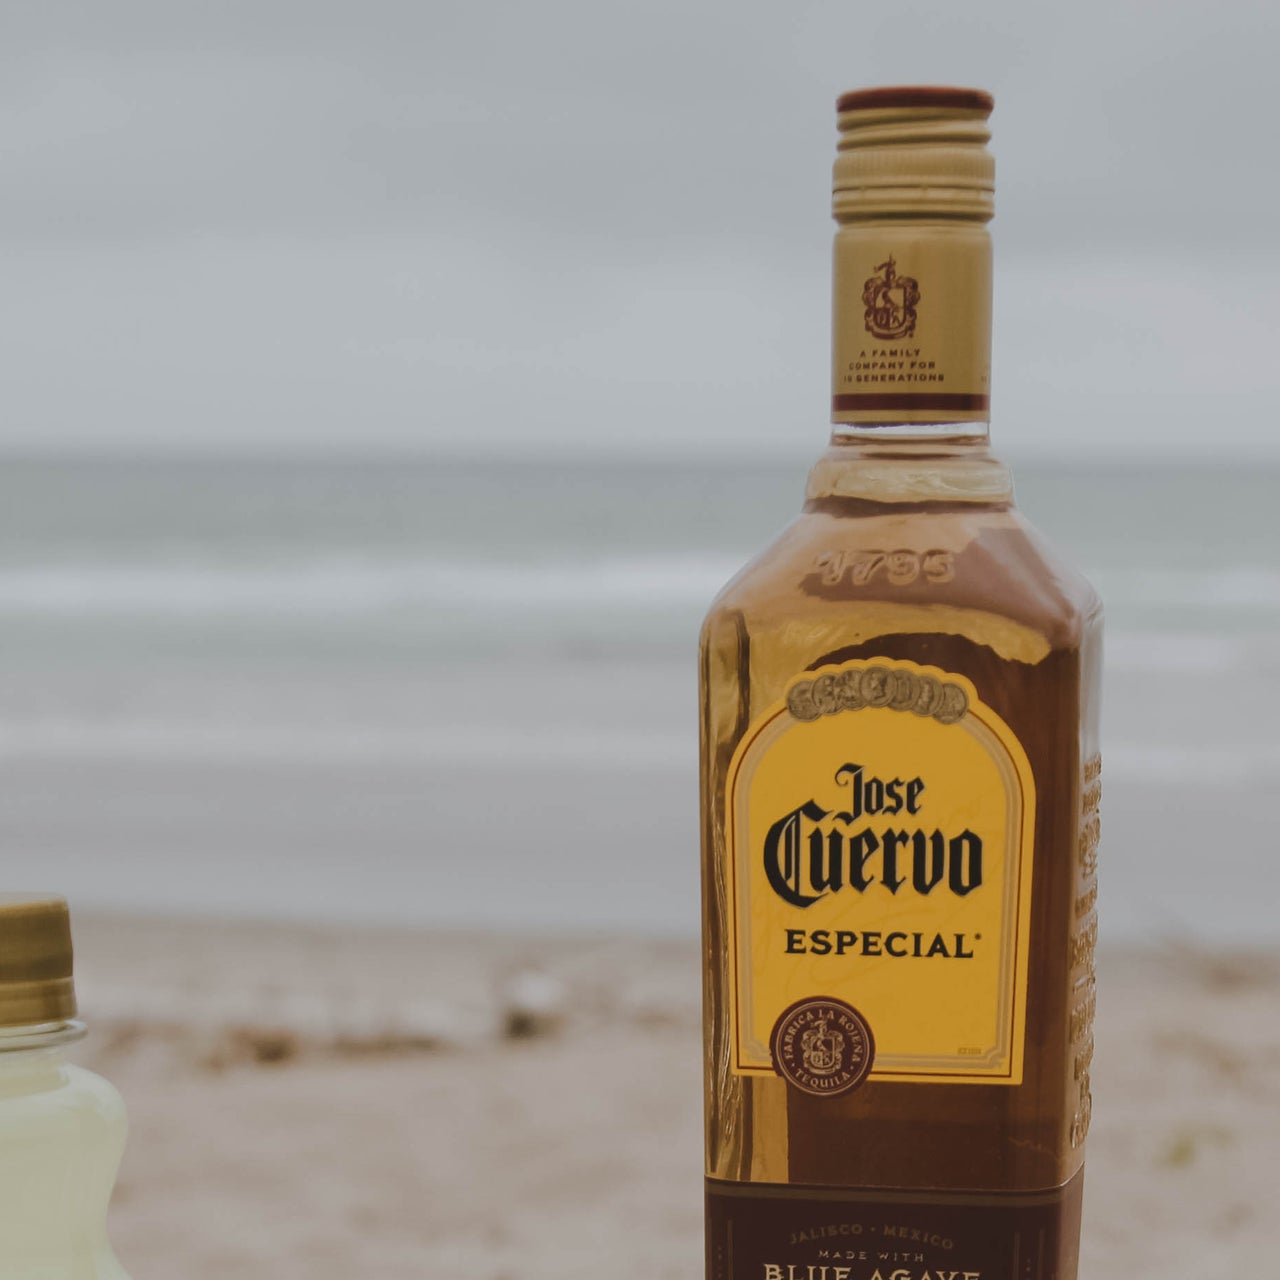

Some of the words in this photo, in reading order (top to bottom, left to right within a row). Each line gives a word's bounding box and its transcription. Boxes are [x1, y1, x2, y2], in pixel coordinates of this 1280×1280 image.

[848, 361, 904, 370] COMPANY
[910, 361, 936, 370] FOR
[872, 348, 920, 358] FAMILY
[856, 373, 945, 383] GENERATIONS
[814, 548, 956, 586] 1795
[832, 762, 925, 826] Jose
[763, 798, 983, 910] Cuervo
[784, 929, 974, 959] ESPECIAL
[784, 1011, 814, 1060] FABRICA
[818, 1009, 834, 1020] LA
[795, 1068, 851, 1088] TEQUILA
[790, 1224, 863, 1245] JALISCO
[883, 1225, 953, 1249] MEXICO
[818, 1250, 867, 1260] MADE
[878, 1252, 924, 1262] WITH
